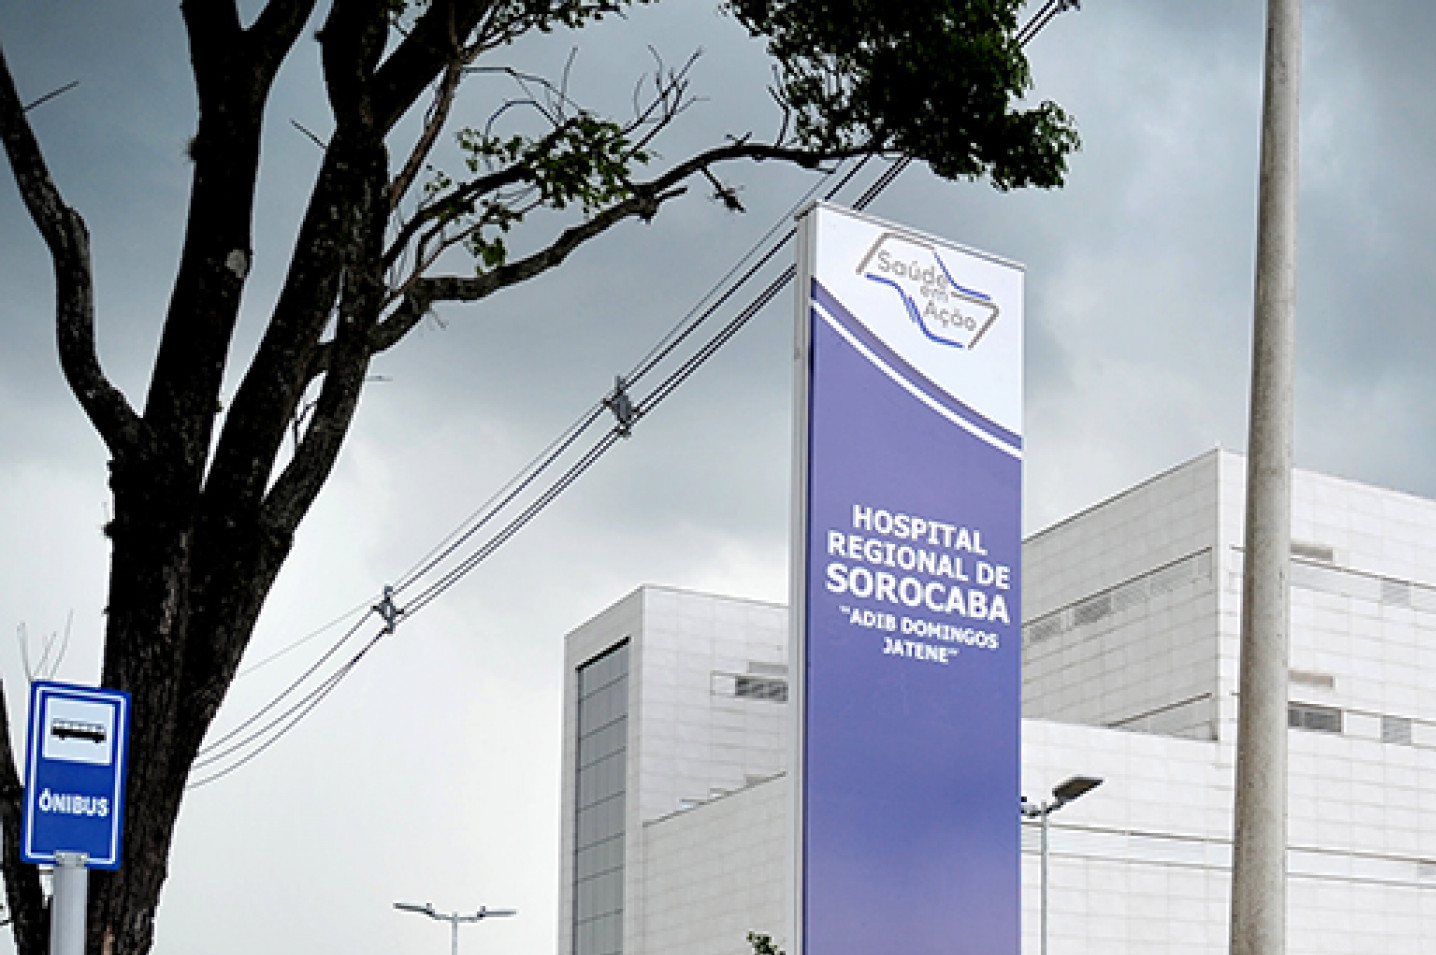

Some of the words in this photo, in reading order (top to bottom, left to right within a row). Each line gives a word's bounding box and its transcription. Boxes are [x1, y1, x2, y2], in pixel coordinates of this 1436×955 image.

[877, 250, 949, 286] Saúde
[919, 284, 950, 304] em
[923, 301, 978, 332] Ação
[852, 504, 988, 556] HOSPITAL
[827, 530, 969, 582] REGIONAL
[975, 560, 1011, 590] DE
[826, 563, 1011, 626] SOROCABA
[900, 616, 1000, 650] DOMINGOS
[38, 787, 110, 817] ÔNIBUS
